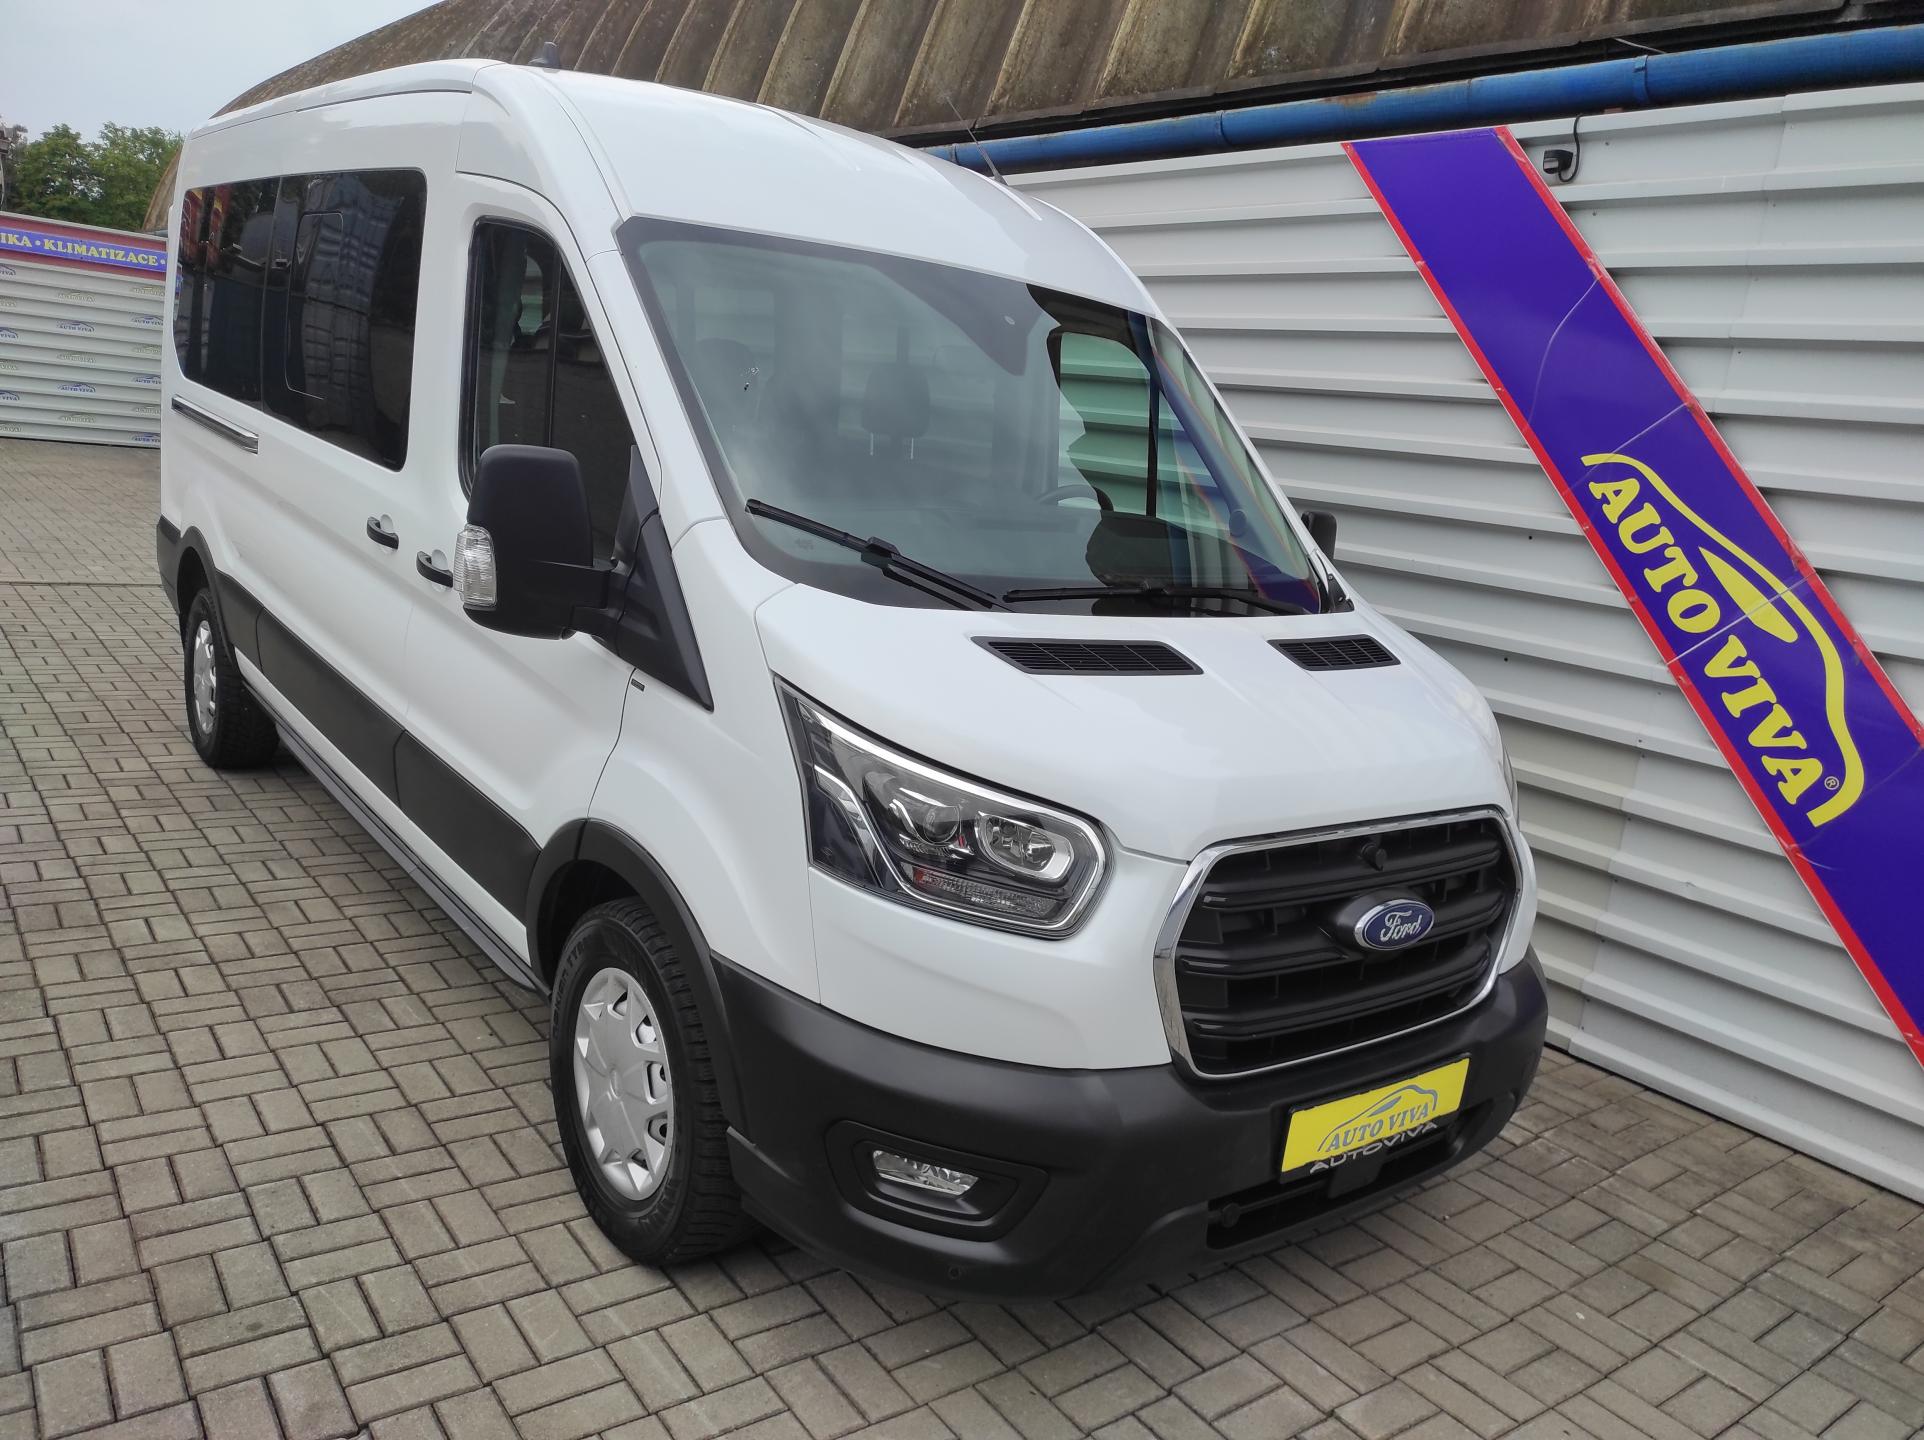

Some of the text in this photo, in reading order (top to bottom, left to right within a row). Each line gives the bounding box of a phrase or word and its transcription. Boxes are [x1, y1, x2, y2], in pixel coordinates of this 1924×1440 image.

[43, 238, 159, 266] KLIMATIZACE
[1588, 478, 1721, 634] AUTO
[1380, 910, 1423, 942] Ford
[1309, 1121, 1438, 1174] AUTOVIVA
[1326, 1102, 1429, 1152] AUTO VIVA
